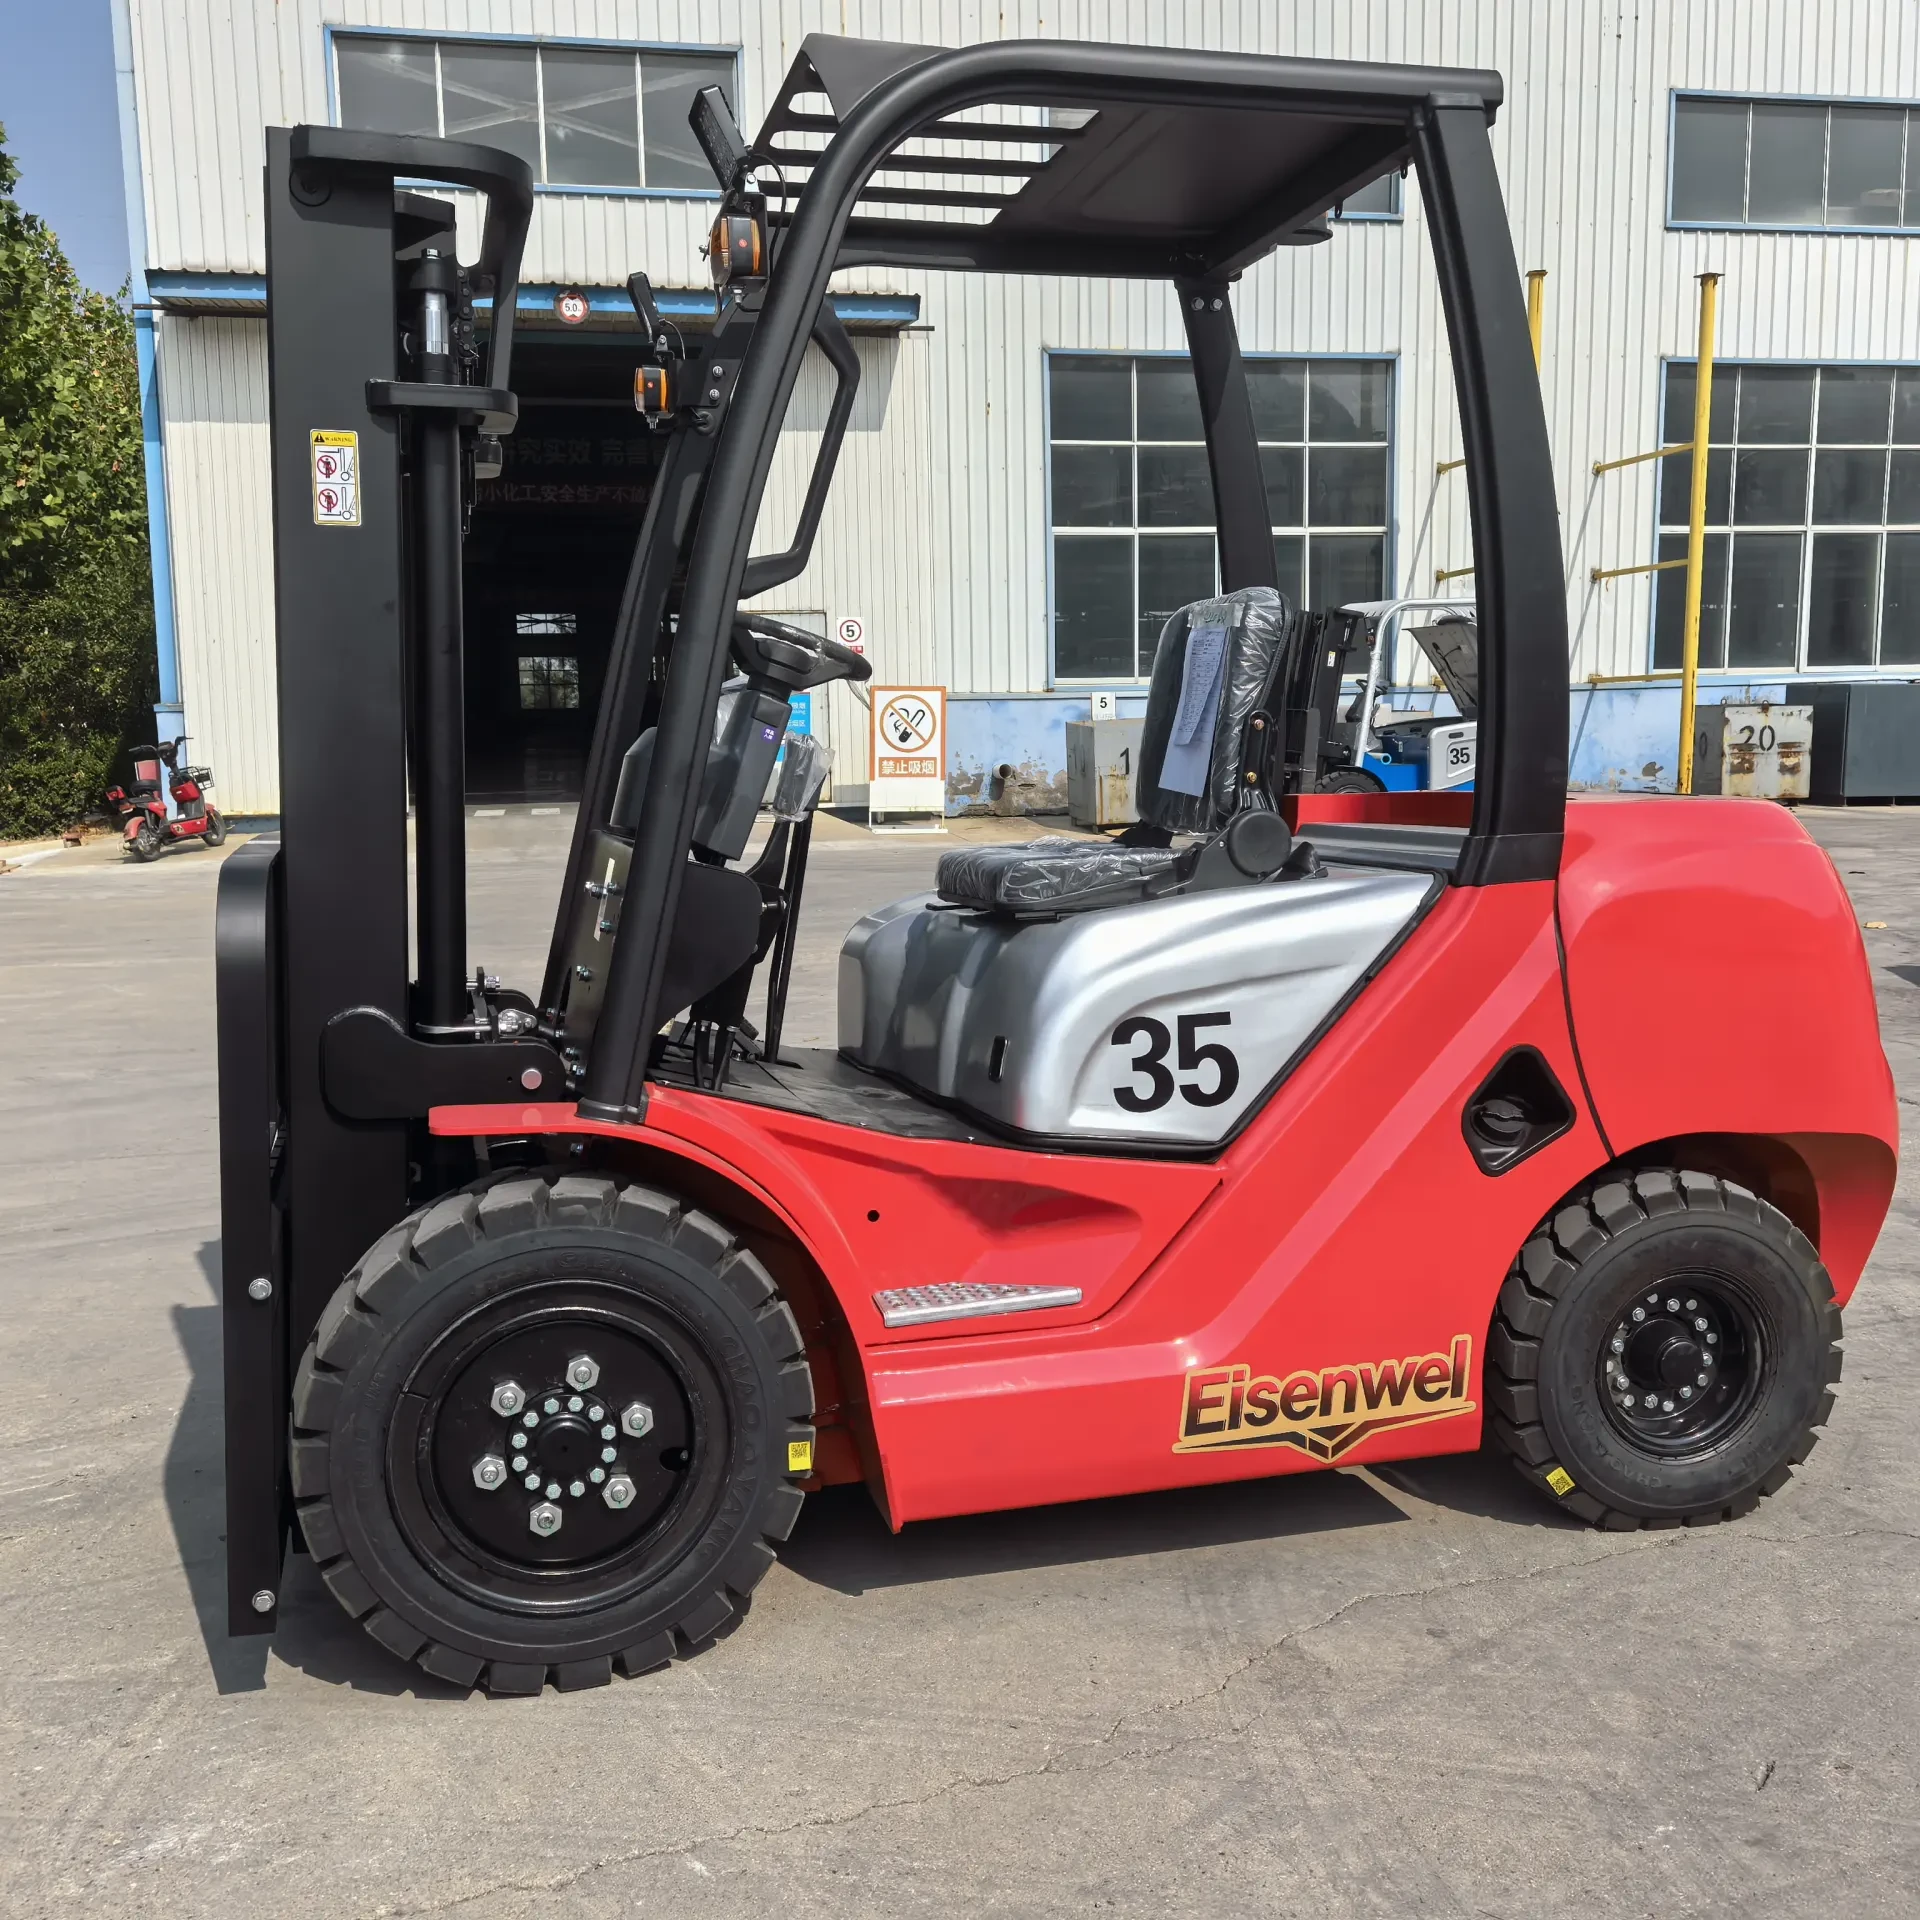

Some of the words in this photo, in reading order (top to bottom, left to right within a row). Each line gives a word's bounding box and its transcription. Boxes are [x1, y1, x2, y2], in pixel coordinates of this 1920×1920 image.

[846, 625, 855, 638] 5
[1099, 696, 1108, 708] 5
[1739, 725, 1776, 751] 20
[1449, 747, 1470, 765] 35
[881, 760, 935, 775] 禁止吸烟
[1111, 1011, 1240, 1113] 35
[1183, 1337, 1471, 1438] Eisenwel
